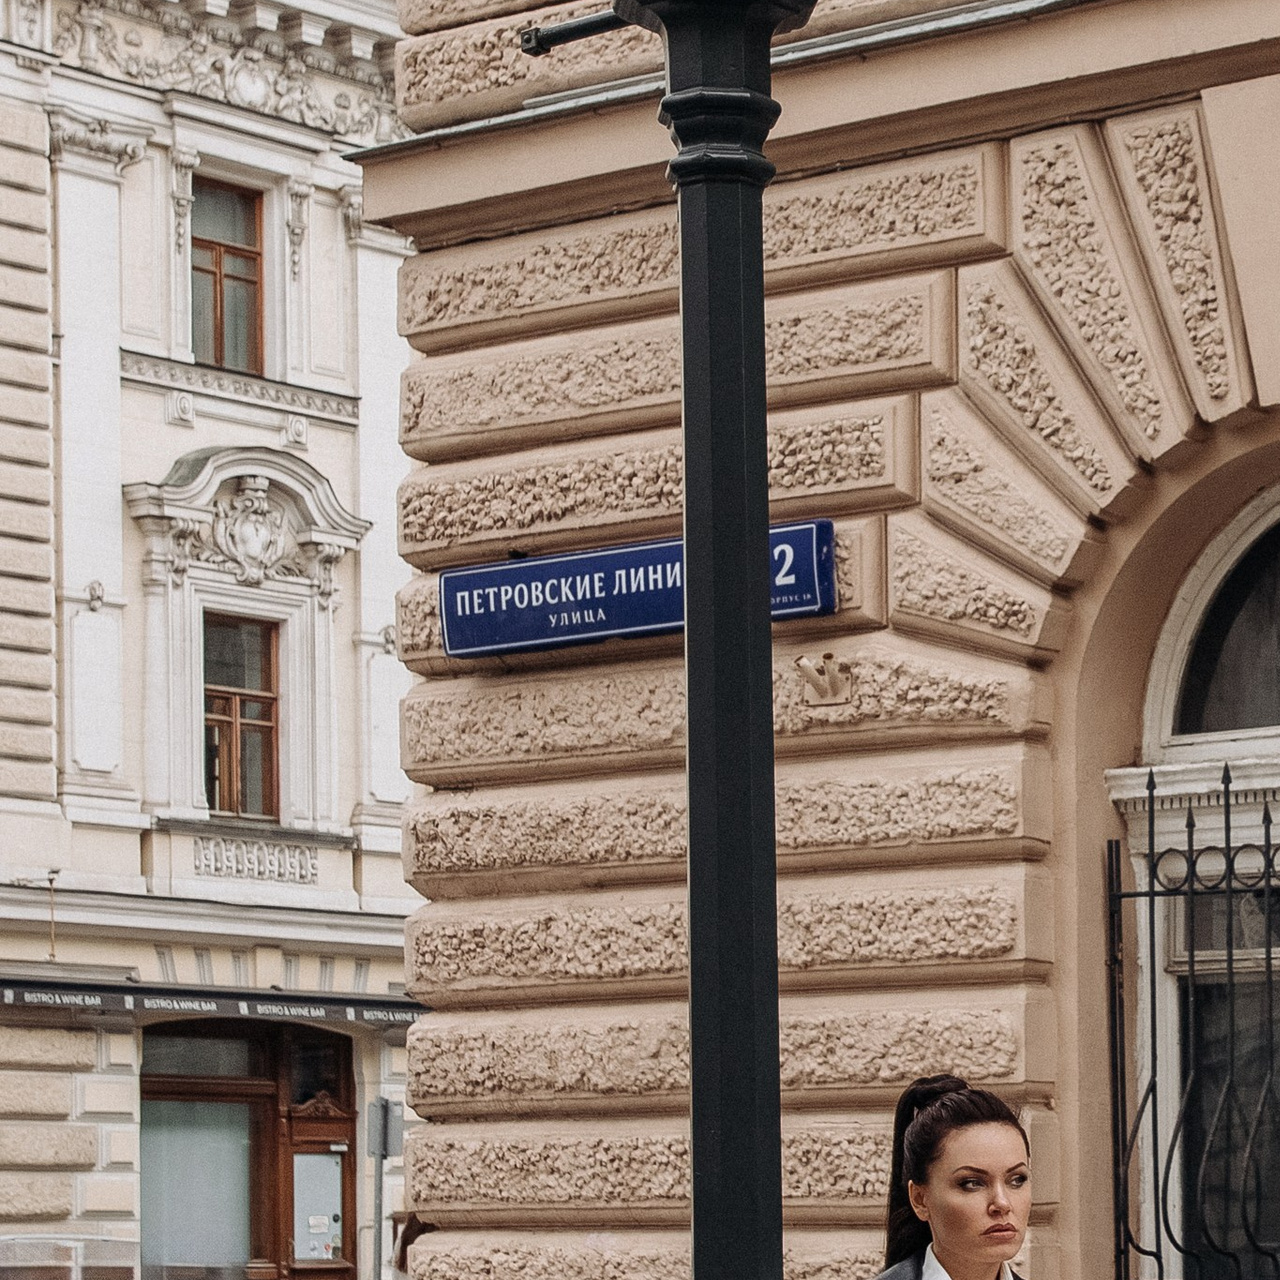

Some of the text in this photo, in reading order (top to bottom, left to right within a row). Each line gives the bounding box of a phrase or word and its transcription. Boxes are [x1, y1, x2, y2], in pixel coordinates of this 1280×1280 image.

[773, 543, 796, 587] 2
[456, 562, 681, 616] ПЕТРОВСКИЕ ЛИНИ
[549, 608, 606, 627] УЛИЦА
[24, 991, 54, 1004] BISTRO
[62, 994, 83, 1005] WINE
[84, 995, 102, 1006] BAR
[144, 998, 173, 1010] BISTRO
[180, 1000, 201, 1011] WINE
[201, 1001, 218, 1012] BAR
[256, 1004, 283, 1015] BISTRO
[290, 1006, 310, 1018] WINE
[310, 1007, 326, 1019] BAR
[363, 1009, 388, 1021] BISTRO
[394, 1011, 413, 1023] WINE
